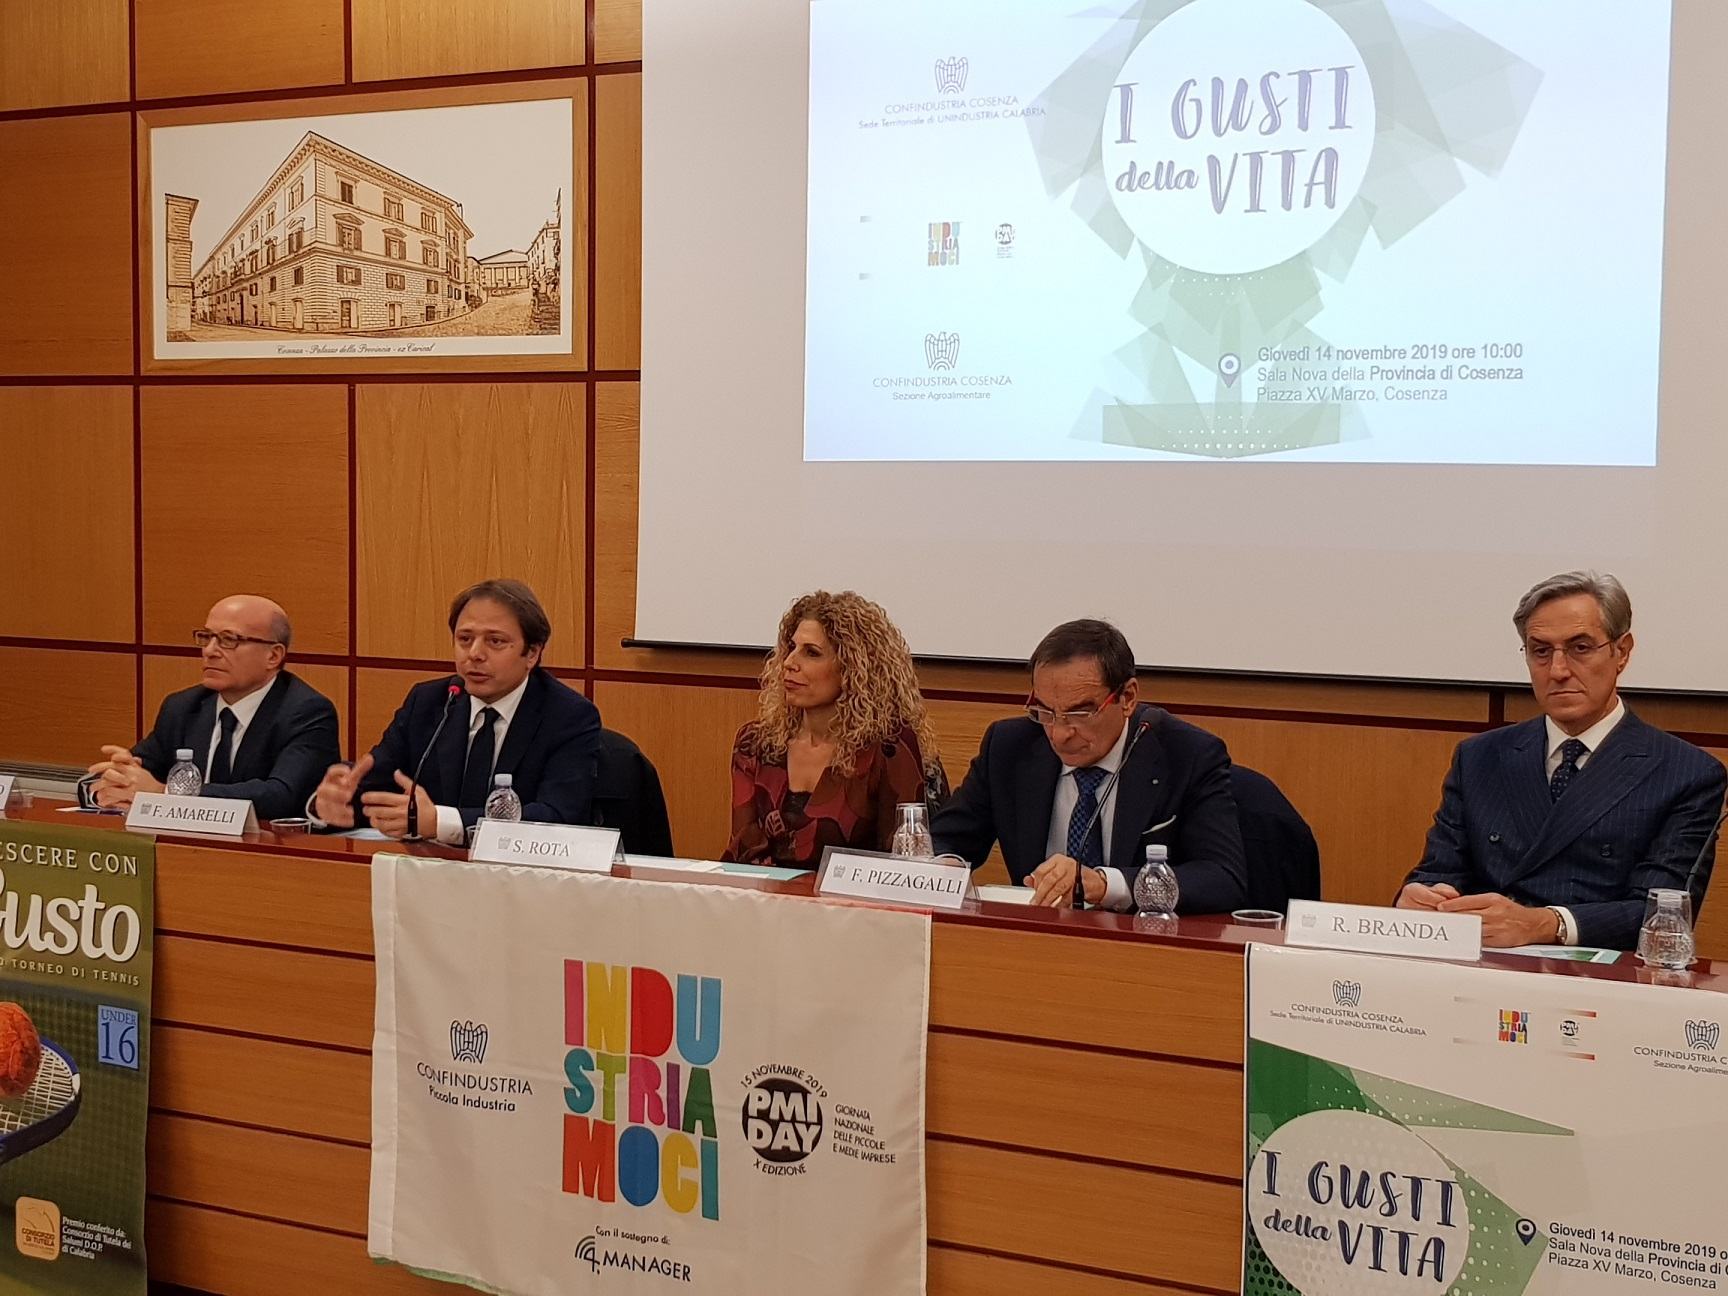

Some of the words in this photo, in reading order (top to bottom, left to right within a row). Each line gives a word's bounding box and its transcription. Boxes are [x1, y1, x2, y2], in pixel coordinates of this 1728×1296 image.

[885, 99, 967, 115] CONFINDUSTRIA
[969, 95, 1020, 108] COSENZA
[937, 110, 999, 124] UNINDUSTRIA
[1001, 106, 1047, 119] CALABRIA
[1113, 82, 1139, 144] I
[1171, 66, 1356, 140] GUSTI
[1114, 160, 1200, 193] della
[1206, 147, 1340, 215] VITA
[1257, 345, 1310, 362] Giovedì
[1315, 346, 1332, 361] 14
[1336, 344, 1407, 361] novembre
[1411, 344, 1448, 359] 2019
[1451, 347, 1476, 359] ore
[1482, 343, 1523, 358] 10:00
[872, 376, 958, 388] CONFINDUSTRIA
[961, 374, 1013, 387] COSENZA
[1257, 367, 1287, 382] Sala
[1292, 367, 1328, 381] Nova
[1331, 365, 1365, 381] della
[1370, 365, 1435, 380] Provincia
[1440, 364, 1453, 380] di
[1458, 365, 1524, 380] Cosenza
[892, 391, 926, 401] Sezione
[927, 390, 992, 402] Agroalimentare
[1257, 386, 1302, 402] Piazza
[1305, 386, 1328, 401] XV
[1384, 385, 1449, 401] Cosenza
[152, 804, 163, 818] F.
[166, 806, 236, 824] AMARELLI
[512, 839, 525, 853] S.
[529, 841, 570, 857] ROTA
[89, 851, 138, 876] CON
[851, 868, 863, 883] F.
[867, 870, 964, 894] PIZZAGALLI
[0, 869, 141, 962] usto
[1333, 916, 1350, 933] R.
[1358, 917, 1449, 941] BRANDA
[12, 958, 64, 975] TORNEO
[72, 967, 86, 977] DI
[93, 969, 140, 986] TENNIS
[101, 1008, 137, 1026] UNDER
[563, 958, 722, 1066] INDU
[1269, 1010, 1287, 1019] Sede
[1326, 1017, 1334, 1025] di
[1335, 1019, 1388, 1032] UNINDUSTRIA
[1389, 1025, 1427, 1036] CALABRIA
[1291, 1003, 1360, 1019] CONFINDUSTRIA
[1361, 1012, 1404, 1024] COSENZA
[101, 1021, 136, 1064] 16
[1633, 1046, 1718, 1063] CONFINDUSTRIA
[1653, 1059, 1686, 1070] Sezione
[417, 1062, 534, 1096] CONFINDUSTRIA
[740, 1075, 753, 1089] 15
[751, 1063, 805, 1080] NOVEMBRE
[805, 1074, 828, 1098] 2019
[429, 1085, 459, 1106] Piccola
[462, 1093, 516, 1112] Industria
[563, 1047, 718, 1139] STRIA
[748, 1087, 818, 1123] PMI
[835, 1104, 871, 1121] GIORNATA
[747, 1118, 821, 1153] DAY
[834, 1118, 875, 1136] NAZIONALE
[833, 1130, 853, 1144] DELLE
[854, 1134, 886, 1151] PICCOLE
[833, 1143, 838, 1153] E
[838, 1144, 859, 1158] MEDIE
[861, 1150, 896, 1164] IMPRESE
[562, 1112, 720, 1221] MOCI
[753, 1158, 761, 1169] X
[762, 1163, 807, 1176] EDIZIONE
[1261, 1149, 1282, 1197] I
[1307, 1160, 1459, 1228] GUSTI
[62, 1226, 94, 1240] Consorzio
[86, 1221, 115, 1235] conferito
[595, 1225, 611, 1237] Con
[613, 1227, 619, 1237] il
[621, 1231, 659, 1244] sostegno
[1549, 1222, 1596, 1241] Giovedì
[1600, 1230, 1615, 1243] 14
[1619, 1233, 1681, 1253] novembre
[1684, 1242, 1716, 1259] 2019
[1263, 1208, 1332, 1242] della
[1337, 1219, 1446, 1283] VITA
[1549, 1237, 1576, 1252] Sala
[1579, 1242, 1612, 1257] Nova
[1615, 1248, 1644, 1263] della
[1648, 1252, 1706, 1272] Provincia
[1709, 1262, 1721, 1275] di
[1548, 1252, 1589, 1269] Piazza
[1592, 1260, 1612, 1273] XV
[1615, 1263, 1657, 1281] Marzo,
[1661, 1270, 1717, 1289] Cosenza
